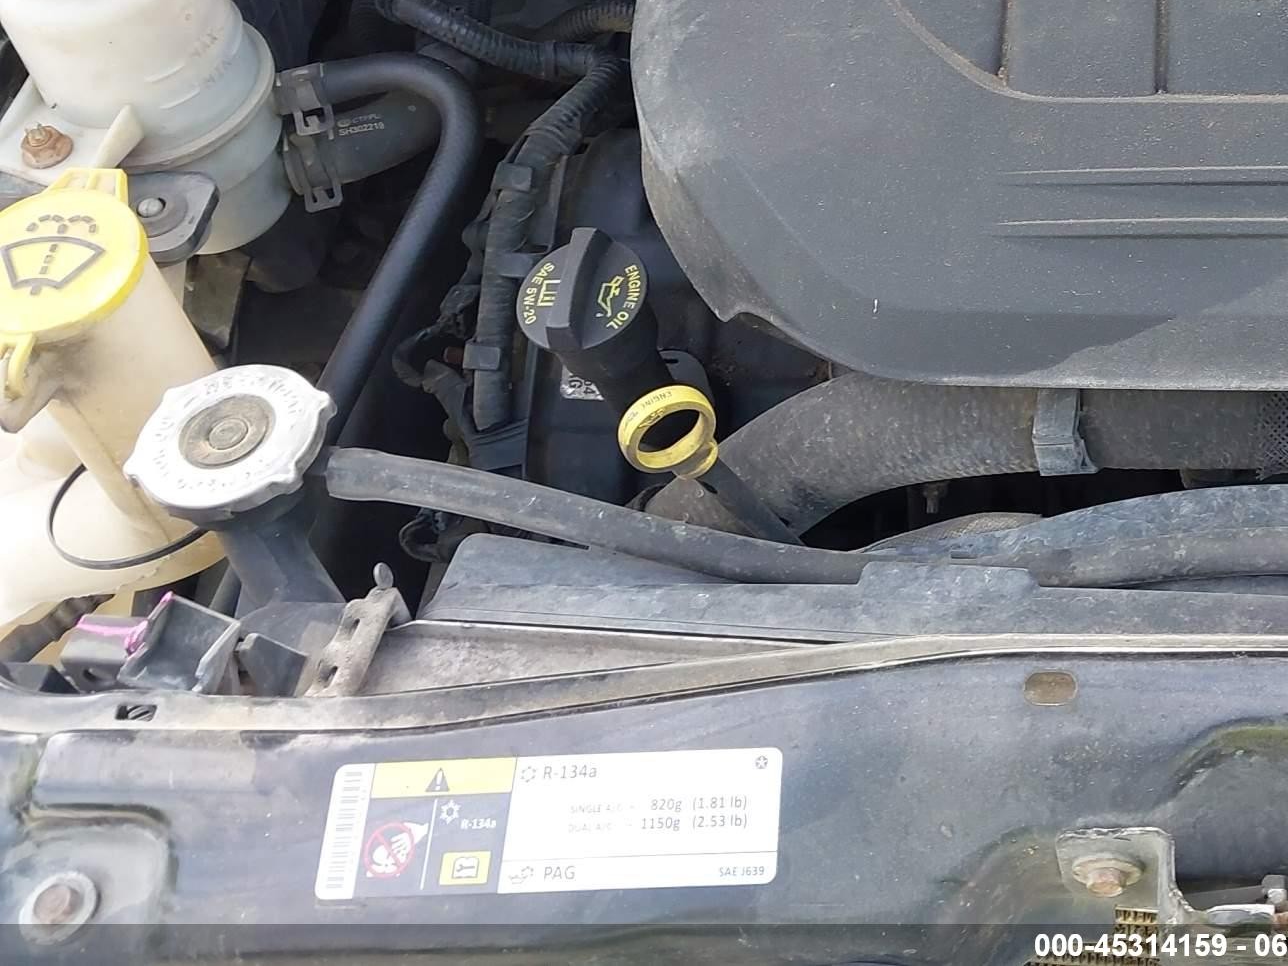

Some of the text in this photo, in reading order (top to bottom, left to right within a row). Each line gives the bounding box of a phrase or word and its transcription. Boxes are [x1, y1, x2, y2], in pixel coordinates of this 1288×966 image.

[522, 262, 554, 325] SAE 5W-20
[606, 264, 641, 330] ENGINE OIL
[543, 763, 598, 781] R-134a
[650, 797, 682, 814] 820g
[692, 796, 725, 813] (1.81
[728, 795, 748, 812] lb)
[641, 817, 681, 833] 1150g
[692, 814, 725, 830] (2.53
[728, 813, 748, 829] lb)
[543, 866, 577, 882] PAG
[718, 865, 766, 878] SAE J639
